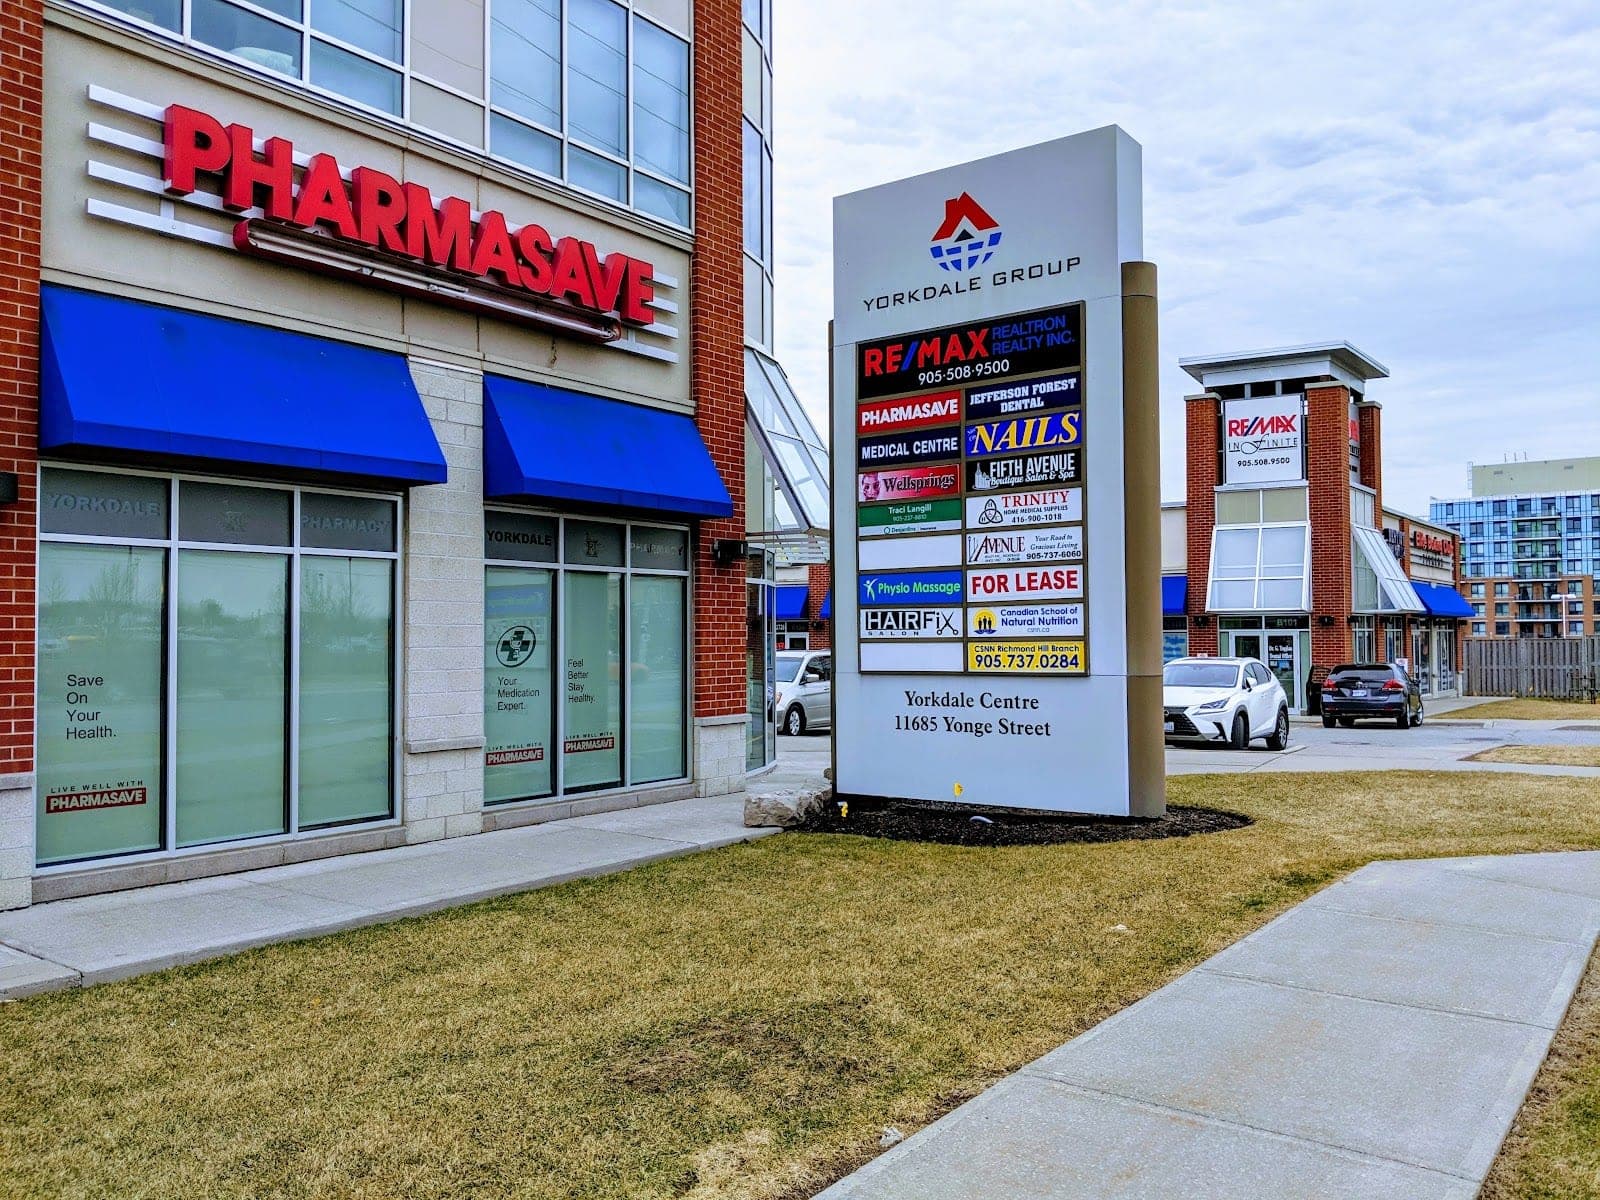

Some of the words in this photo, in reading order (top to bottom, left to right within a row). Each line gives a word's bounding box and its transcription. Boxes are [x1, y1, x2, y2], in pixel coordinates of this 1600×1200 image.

[164, 104, 655, 326] PHARMASAVE
[863, 276, 982, 312] YORKDALE
[992, 256, 1081, 286] GROUP
[864, 328, 990, 377] RE/MAX
[992, 315, 1067, 340] REALTRON
[992, 336, 1043, 356] REALTY
[1046, 330, 1076, 348] INC.
[970, 385, 1030, 406] JEFFERSON
[1032, 378, 1077, 395] FOREST
[1000, 397, 1045, 413] DENTAL
[861, 399, 959, 427] PHARMASAVE
[971, 413, 1079, 453] NAILS
[1228, 414, 1297, 437] RE/MAX
[861, 442, 910, 460] MEDICAL
[912, 437, 958, 455] CENTRE
[989, 458, 1023, 479] FIFTH
[1026, 452, 1076, 474] AVENUE
[1237, 457, 1290, 467] 905.508.9500
[882, 473, 956, 493] Wellsprings
[990, 475, 1024, 487] Boutique
[1025, 471, 1048, 482] Salon
[1058, 469, 1076, 481] Spa
[48, 494, 161, 517] YORKDALE
[1002, 490, 1070, 508] TRINITY
[907, 504, 932, 514] Langill
[1011, 513, 1063, 524] 416-900-1018
[486, 529, 553, 547] YORKDALE
[974, 536, 1026, 562] AVENUE
[1057, 542, 1079, 550] Living
[1026, 550, 1082, 560] 905-737-6060
[878, 582, 910, 596] Physio
[912, 582, 961, 595] Massage
[971, 574, 1010, 595] FOR
[1015, 570, 1078, 592] LEASE
[1000, 608, 1039, 617] Canadian
[1040, 607, 1068, 616] School
[1069, 606, 1079, 614] of
[1001, 617, 1036, 626] Natural
[1038, 616, 1078, 626] Nutrition
[974, 645, 995, 653] CSNN
[997, 645, 1036, 653] Richmond
[1051, 645, 1080, 653] Branch
[567, 659, 584, 668] Feel
[975, 654, 1080, 669] 905.737.0284
[67, 675, 104, 687] Save
[497, 676, 518, 686] Your
[567, 670, 589, 680] Better
[497, 688, 540, 698] Medication
[568, 682, 585, 693] Stay
[66, 691, 88, 705] On
[568, 694, 596, 704] Healthy.
[904, 690, 975, 708] Yorkdale
[979, 692, 1040, 710] Centre
[497, 702, 526, 712] Expert.
[66, 709, 101, 722] Your
[66, 726, 117, 740] Health.
[895, 715, 938, 732] 11685
[942, 716, 993, 738] Yonge
[998, 717, 1051, 736] Street
[565, 739, 614, 752] PHARMASAVE
[487, 749, 542, 765] PHARMASAVE
[50, 785, 76, 794] LIVE
[82, 782, 112, 791] WELL
[117, 779, 144, 787] WITH
[50, 789, 144, 811] PHARMASAVE
